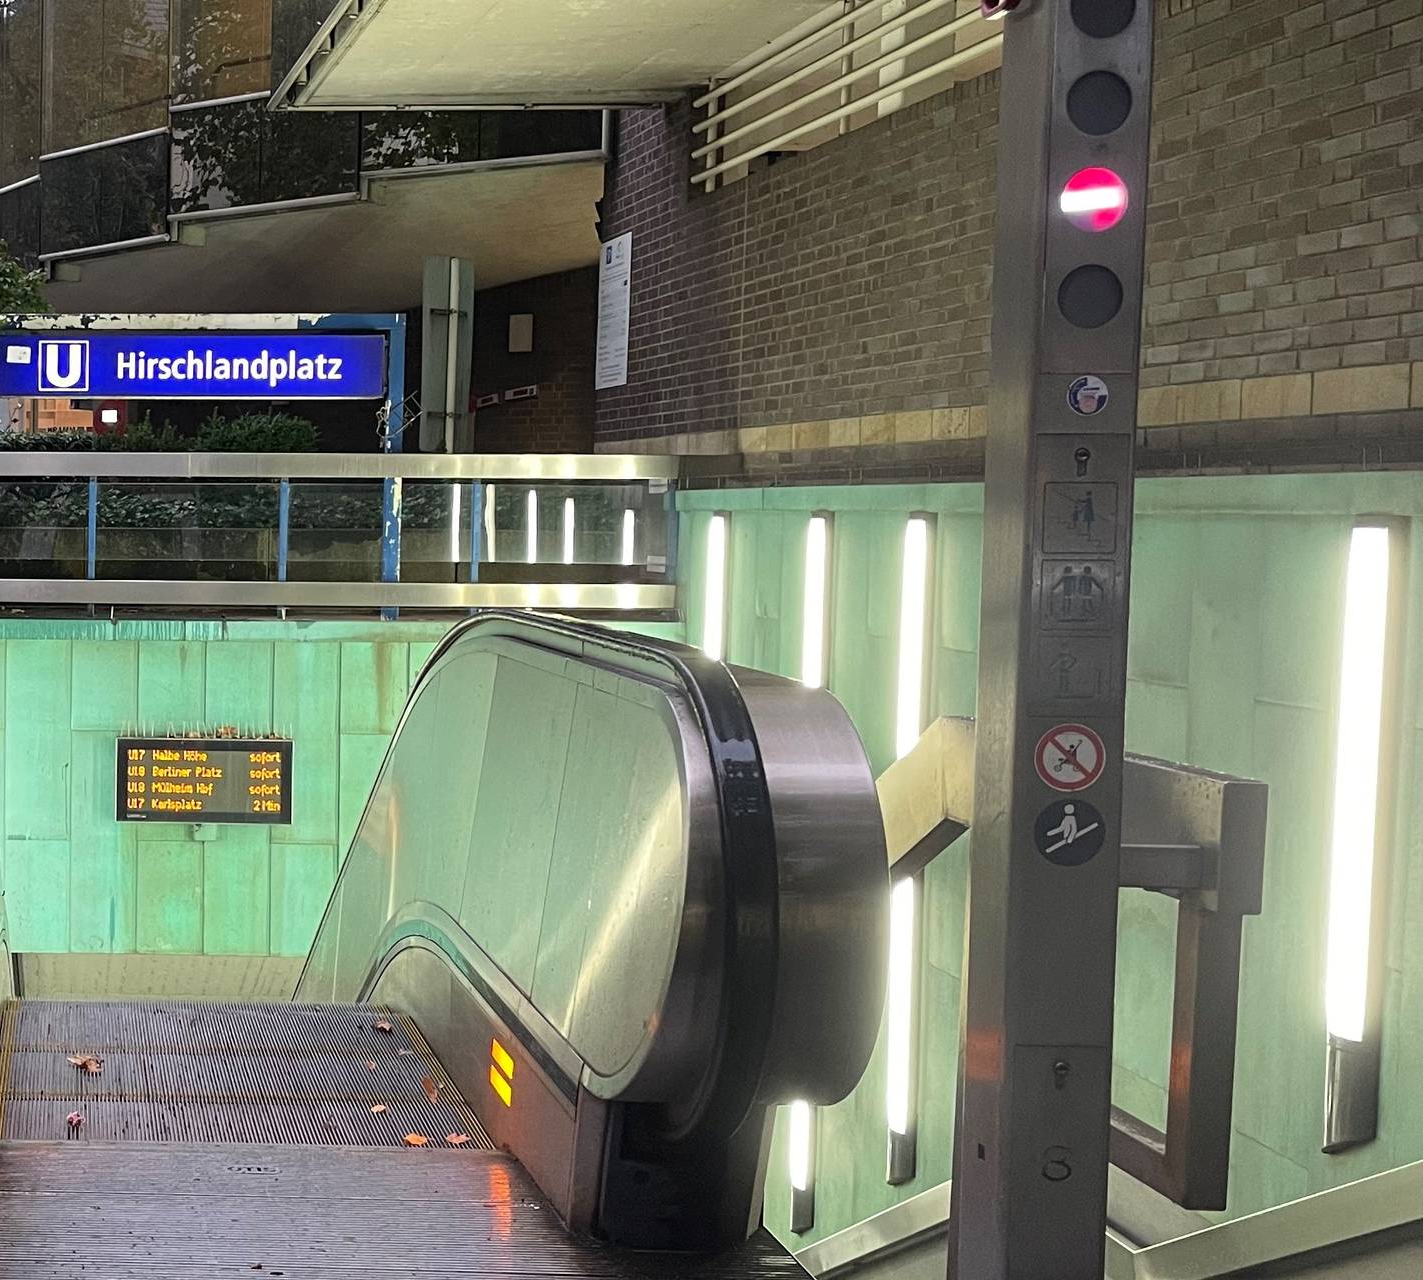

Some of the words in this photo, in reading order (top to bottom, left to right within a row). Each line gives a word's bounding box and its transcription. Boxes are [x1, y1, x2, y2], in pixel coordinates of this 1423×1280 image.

[45, 344, 82, 387] U
[116, 350, 343, 387] Hirschlandplatz
[128, 749, 146, 761] U17
[152, 749, 180, 761] Halbe
[183, 750, 208, 762] Höhe
[249, 752, 281, 764] sofort
[127, 766, 146, 777] U18
[152, 766, 192, 777] Berliner
[195, 766, 223, 778] Platz
[249, 768, 281, 780] sofort
[127, 782, 145, 793] U18
[249, 784, 281, 797] sofort
[127, 798, 145, 809] U17
[151, 799, 202, 812] Karlsplatz
[253, 800, 261, 811] 2
